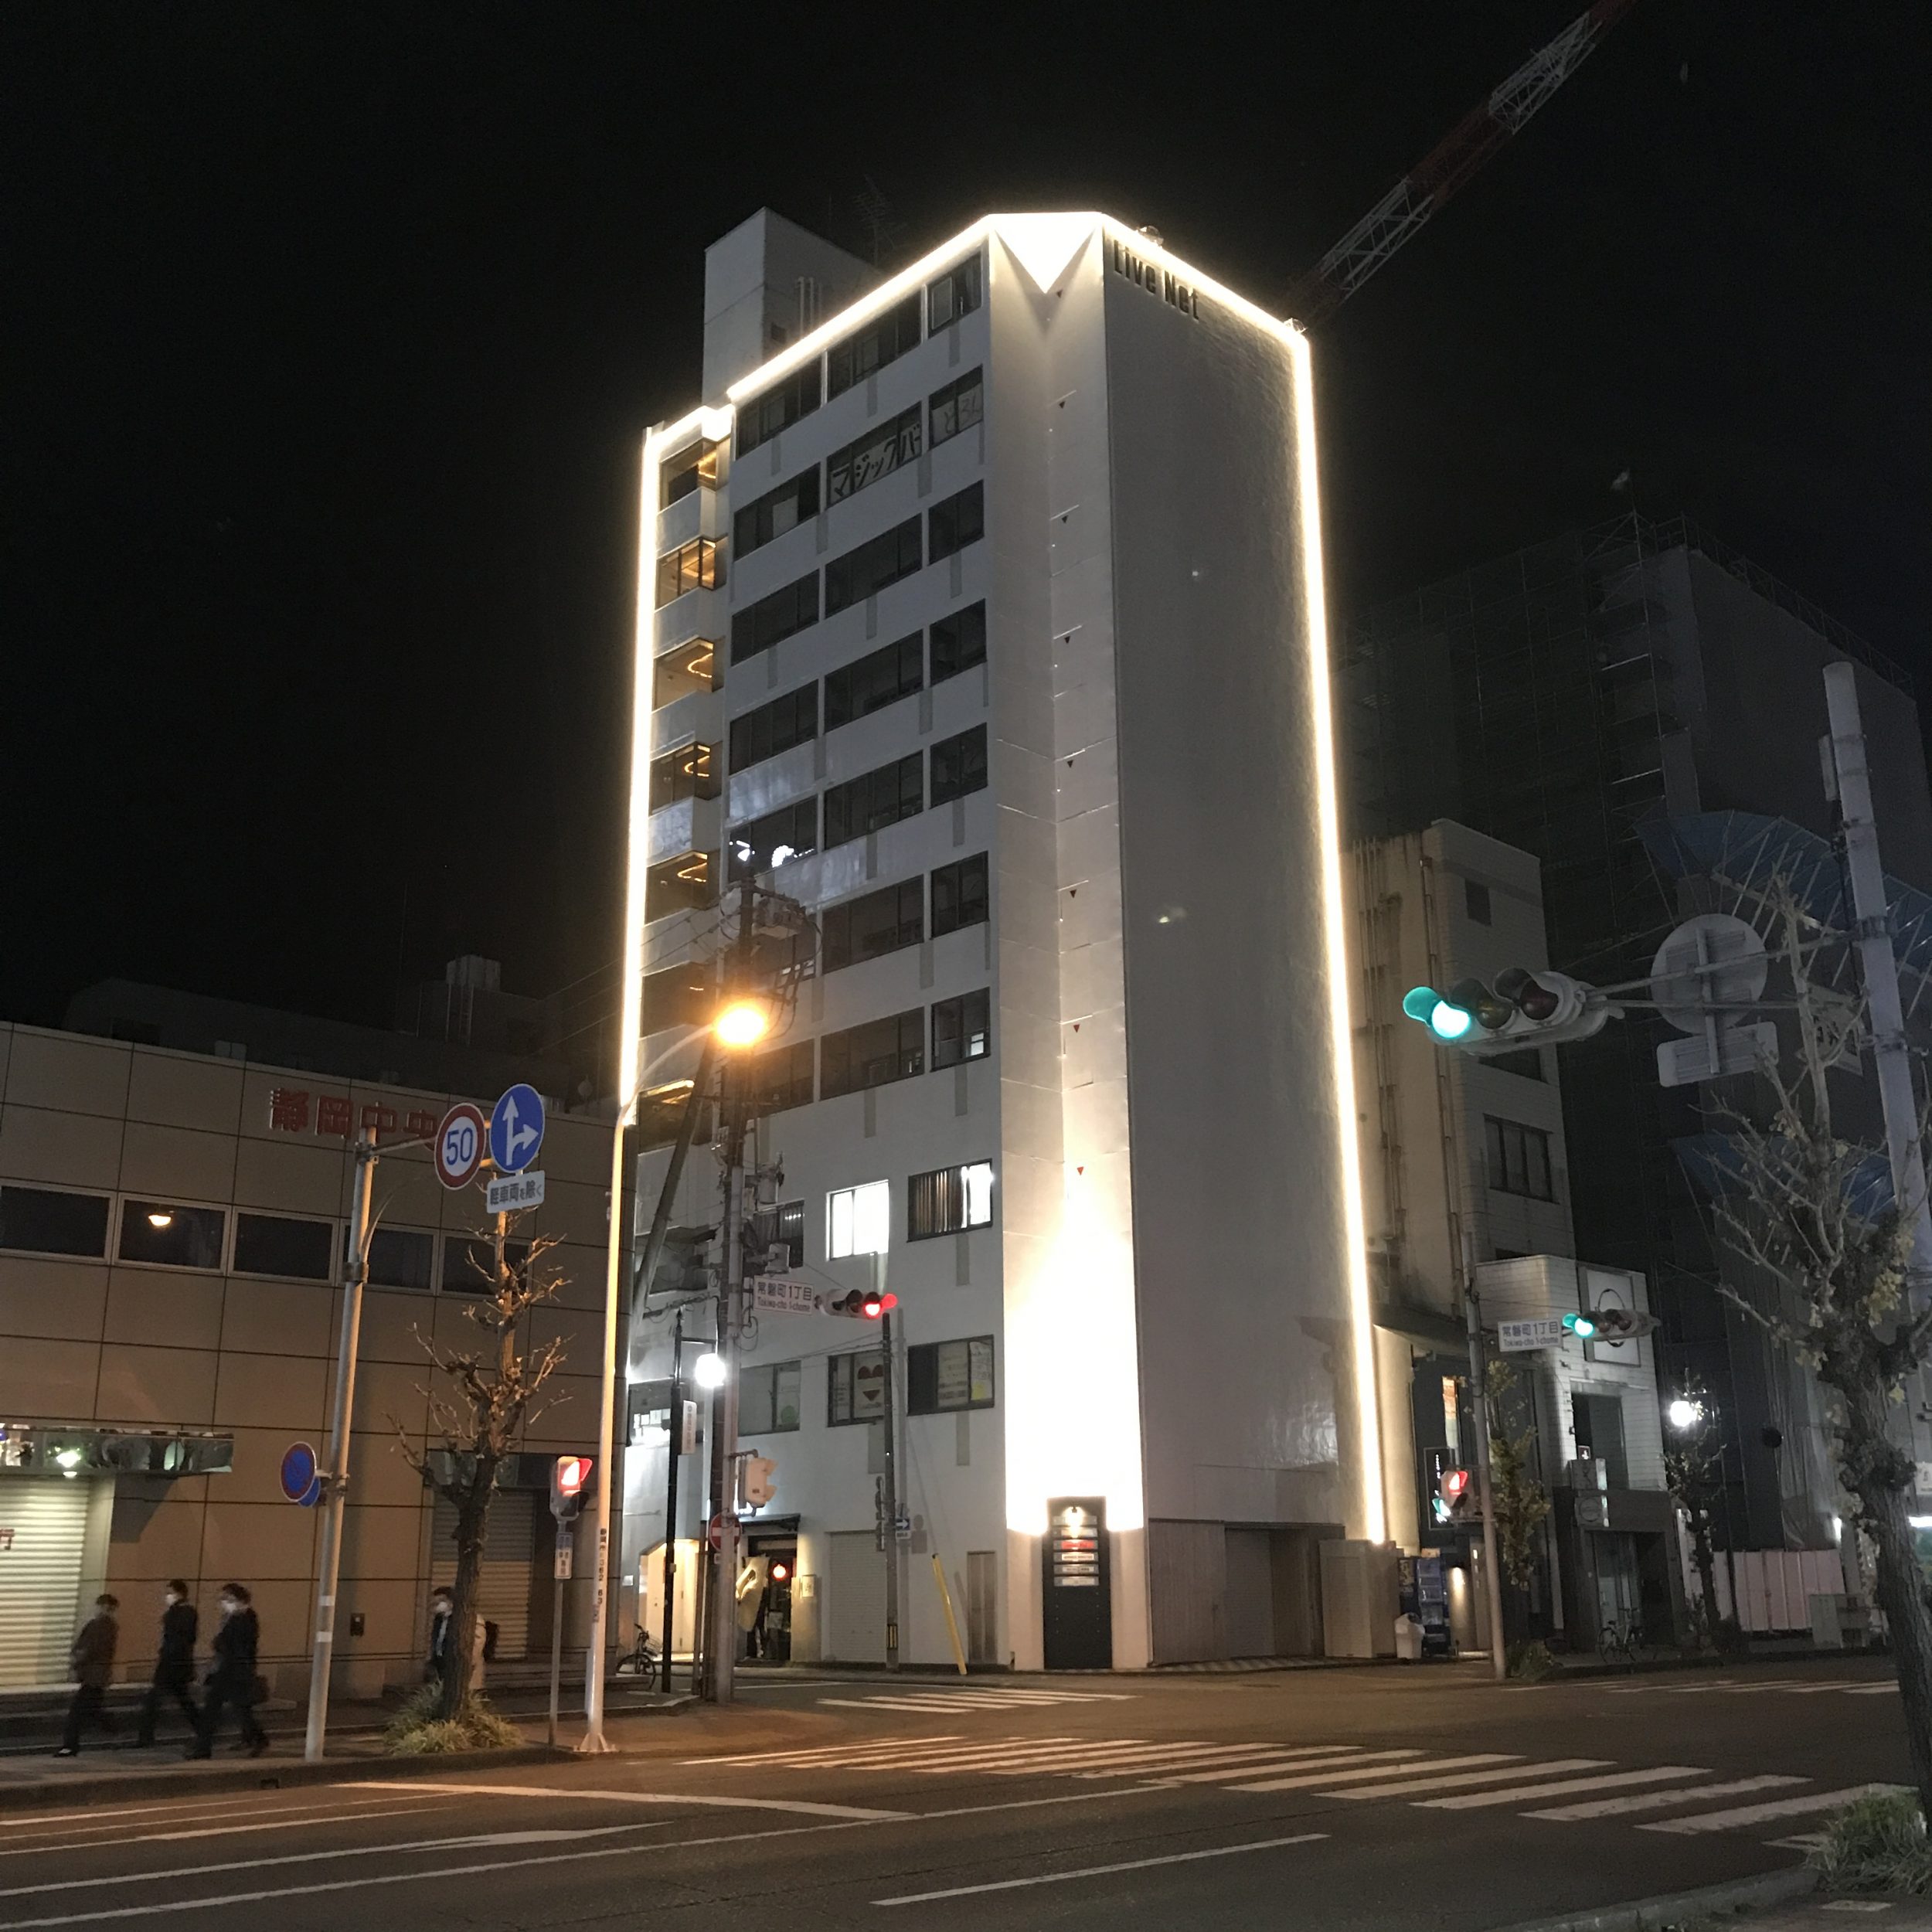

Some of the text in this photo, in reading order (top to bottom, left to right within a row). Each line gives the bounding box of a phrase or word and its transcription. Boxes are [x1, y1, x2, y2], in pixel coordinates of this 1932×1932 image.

[1114, 240, 1199, 320] Live Net
[446, 1127, 473, 1165] 50
[490, 1179, 543, 1206] 軽車両を除く
